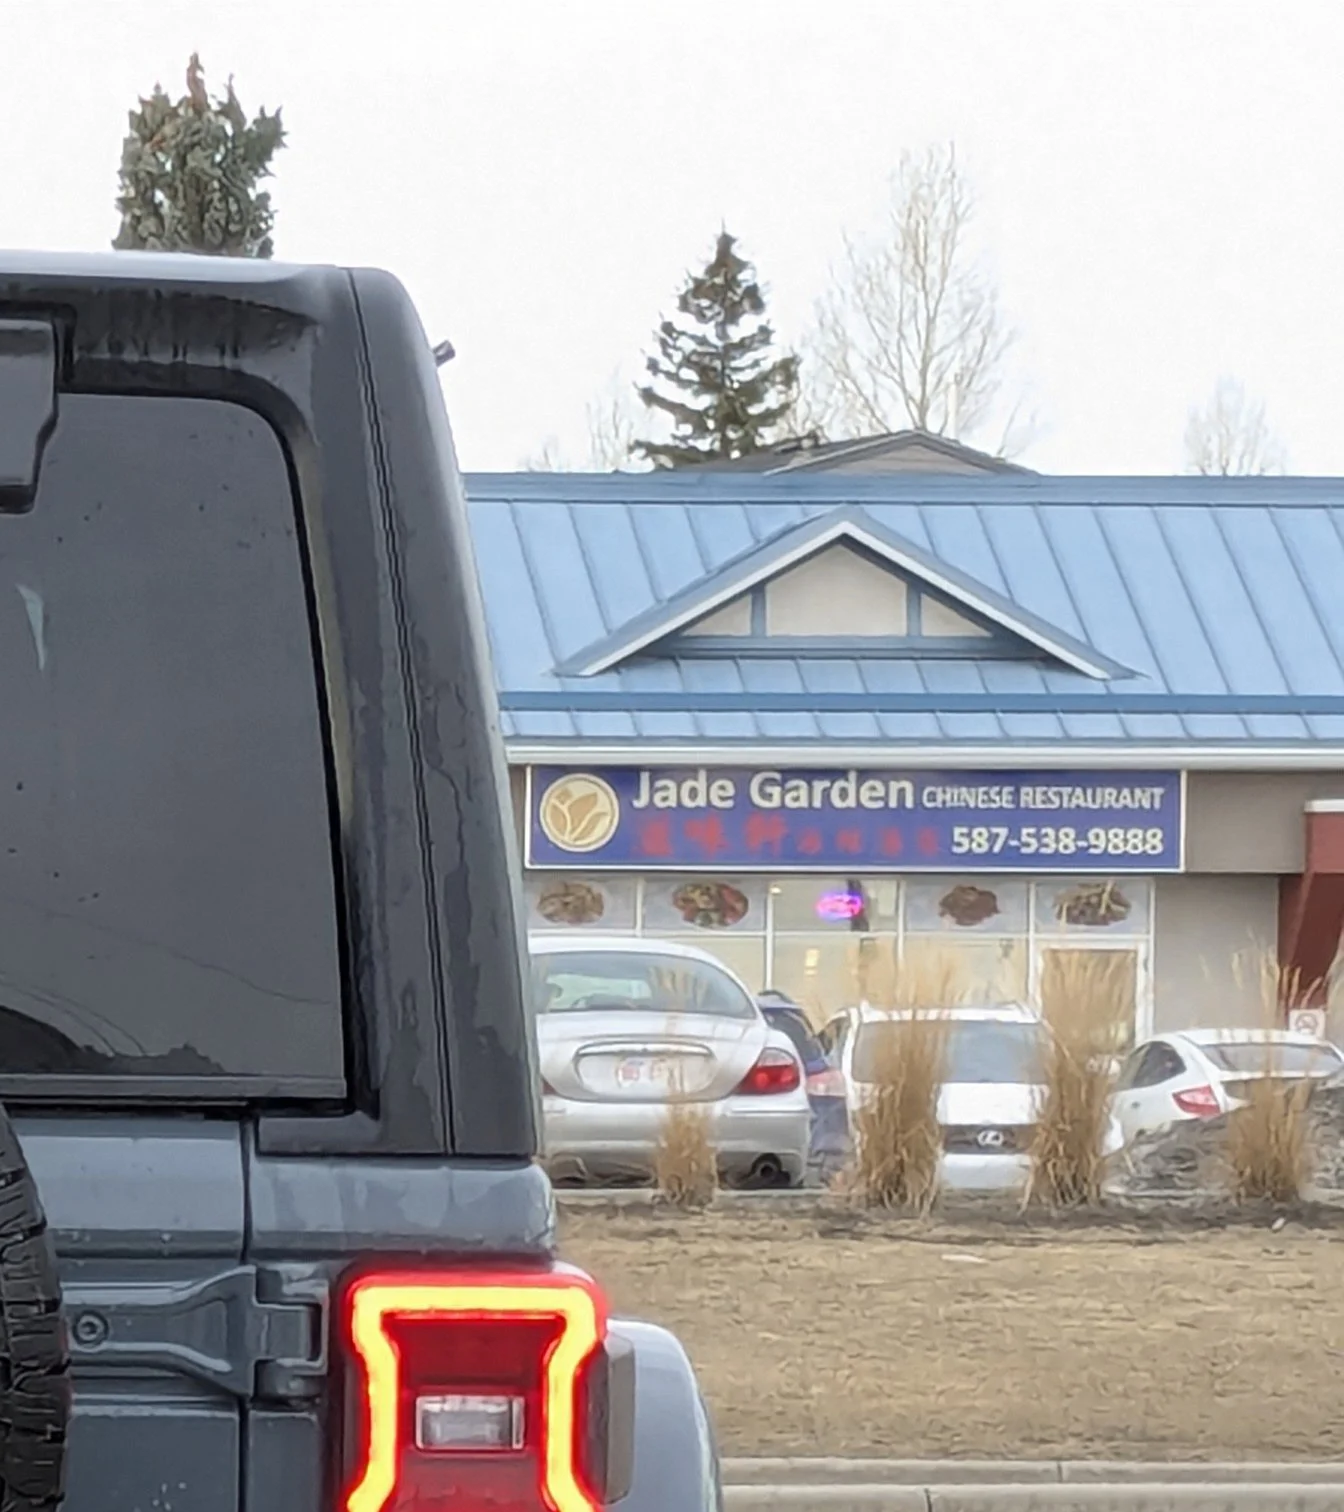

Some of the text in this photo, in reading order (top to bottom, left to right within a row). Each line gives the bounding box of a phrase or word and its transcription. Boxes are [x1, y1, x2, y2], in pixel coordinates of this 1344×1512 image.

[633, 769, 1165, 810] Jade Garden CHINESE RESTAURANT
[951, 826, 1164, 855] 587-538-9888
